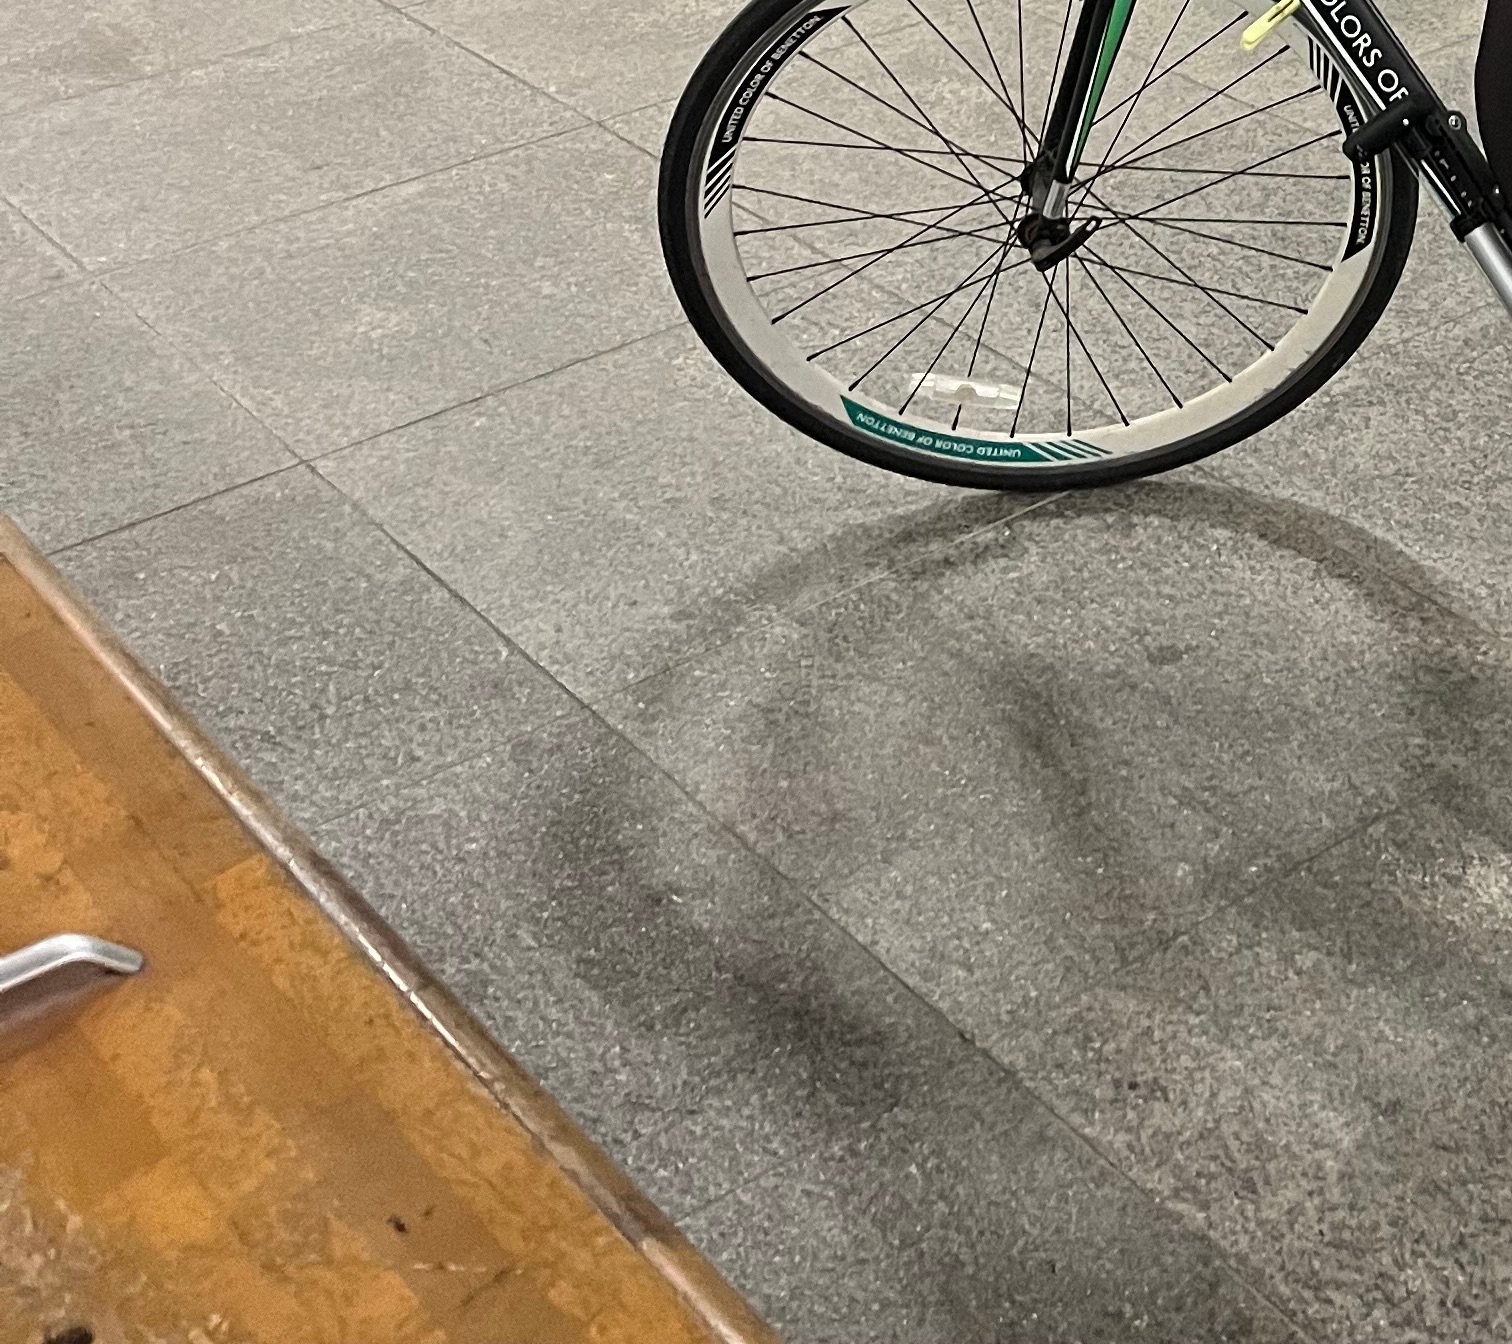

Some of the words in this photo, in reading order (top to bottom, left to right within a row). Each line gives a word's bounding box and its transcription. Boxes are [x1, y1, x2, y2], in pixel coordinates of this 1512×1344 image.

[722, 106, 745, 143] UNITED
[738, 73, 766, 106] COLOR
[760, 59, 774, 73] OF
[770, 14, 822, 61] BENETTON
[1376, 67, 1410, 102] OF
[856, 412, 917, 441] BENETTON
[917, 436, 933, 446] OF
[934, 440, 974, 454] COLOR
[976, 447, 1022, 458] UNITED
